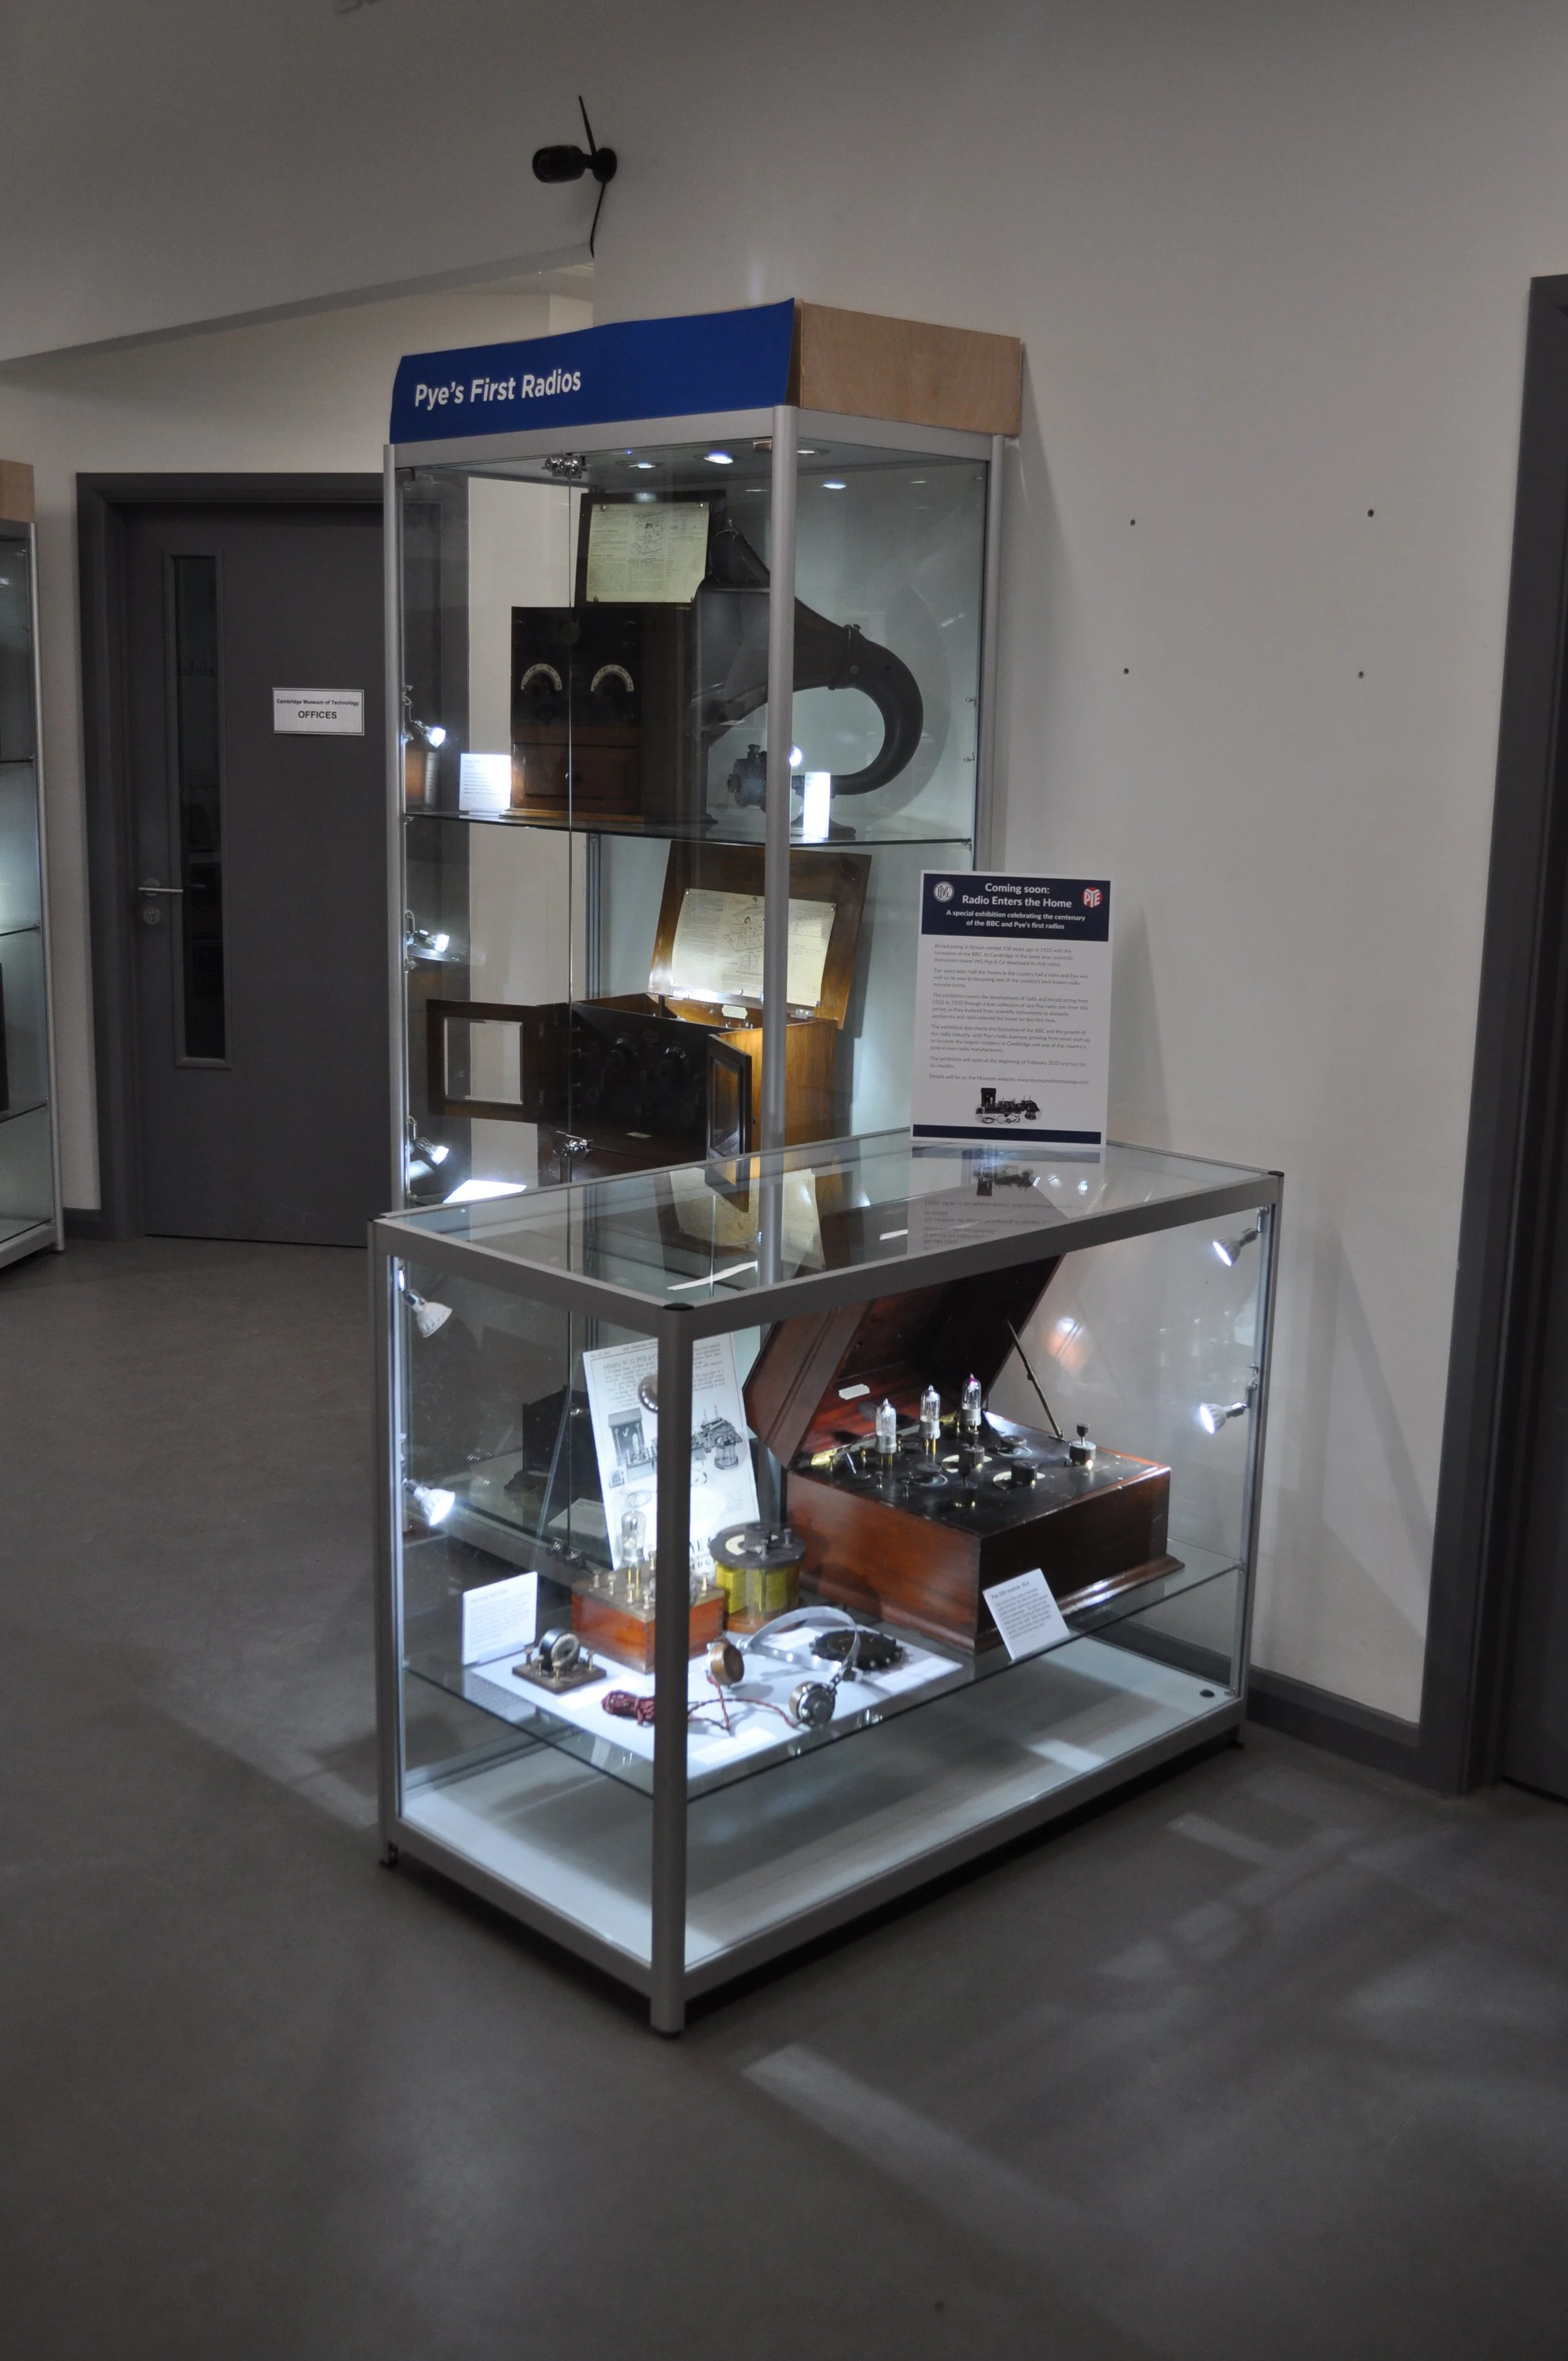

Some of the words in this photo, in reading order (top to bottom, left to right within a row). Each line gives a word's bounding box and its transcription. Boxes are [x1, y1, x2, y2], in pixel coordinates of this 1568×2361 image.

[415, 381, 464, 410] Pye's
[470, 377, 515, 402] First
[521, 369, 581, 398] Radios
[298, 711, 337, 719] OFFICES
[985, 883, 1022, 894] Coming
[961, 895, 990, 904] Radio
[991, 896, 1022, 905] Enters
[1024, 897, 1041, 906] the
[1042, 898, 1072, 907] Home
[1084, 888, 1101, 908] PYE
